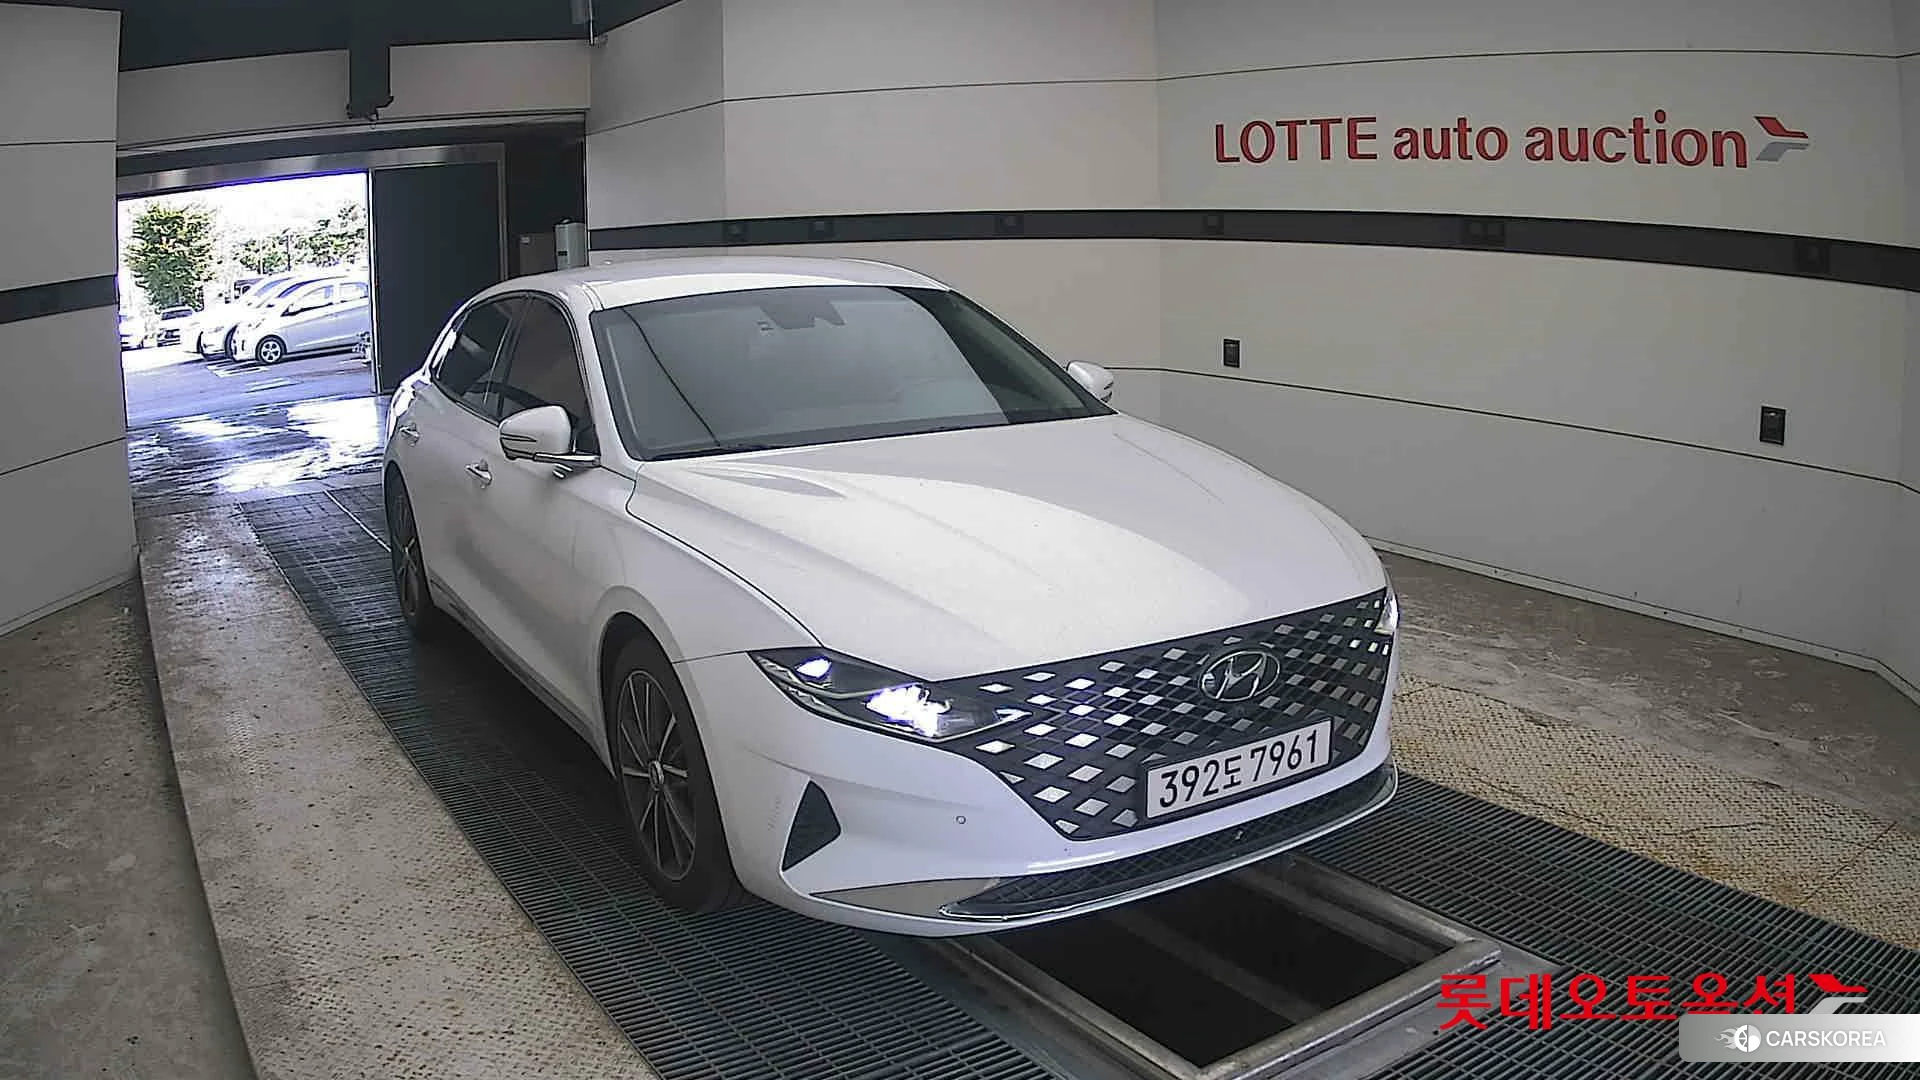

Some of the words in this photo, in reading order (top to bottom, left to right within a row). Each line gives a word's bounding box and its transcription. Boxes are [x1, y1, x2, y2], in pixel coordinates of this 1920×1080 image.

[1215, 116, 1378, 163] LOTTE
[1393, 116, 1509, 161] auto
[1524, 109, 1749, 169] auction
